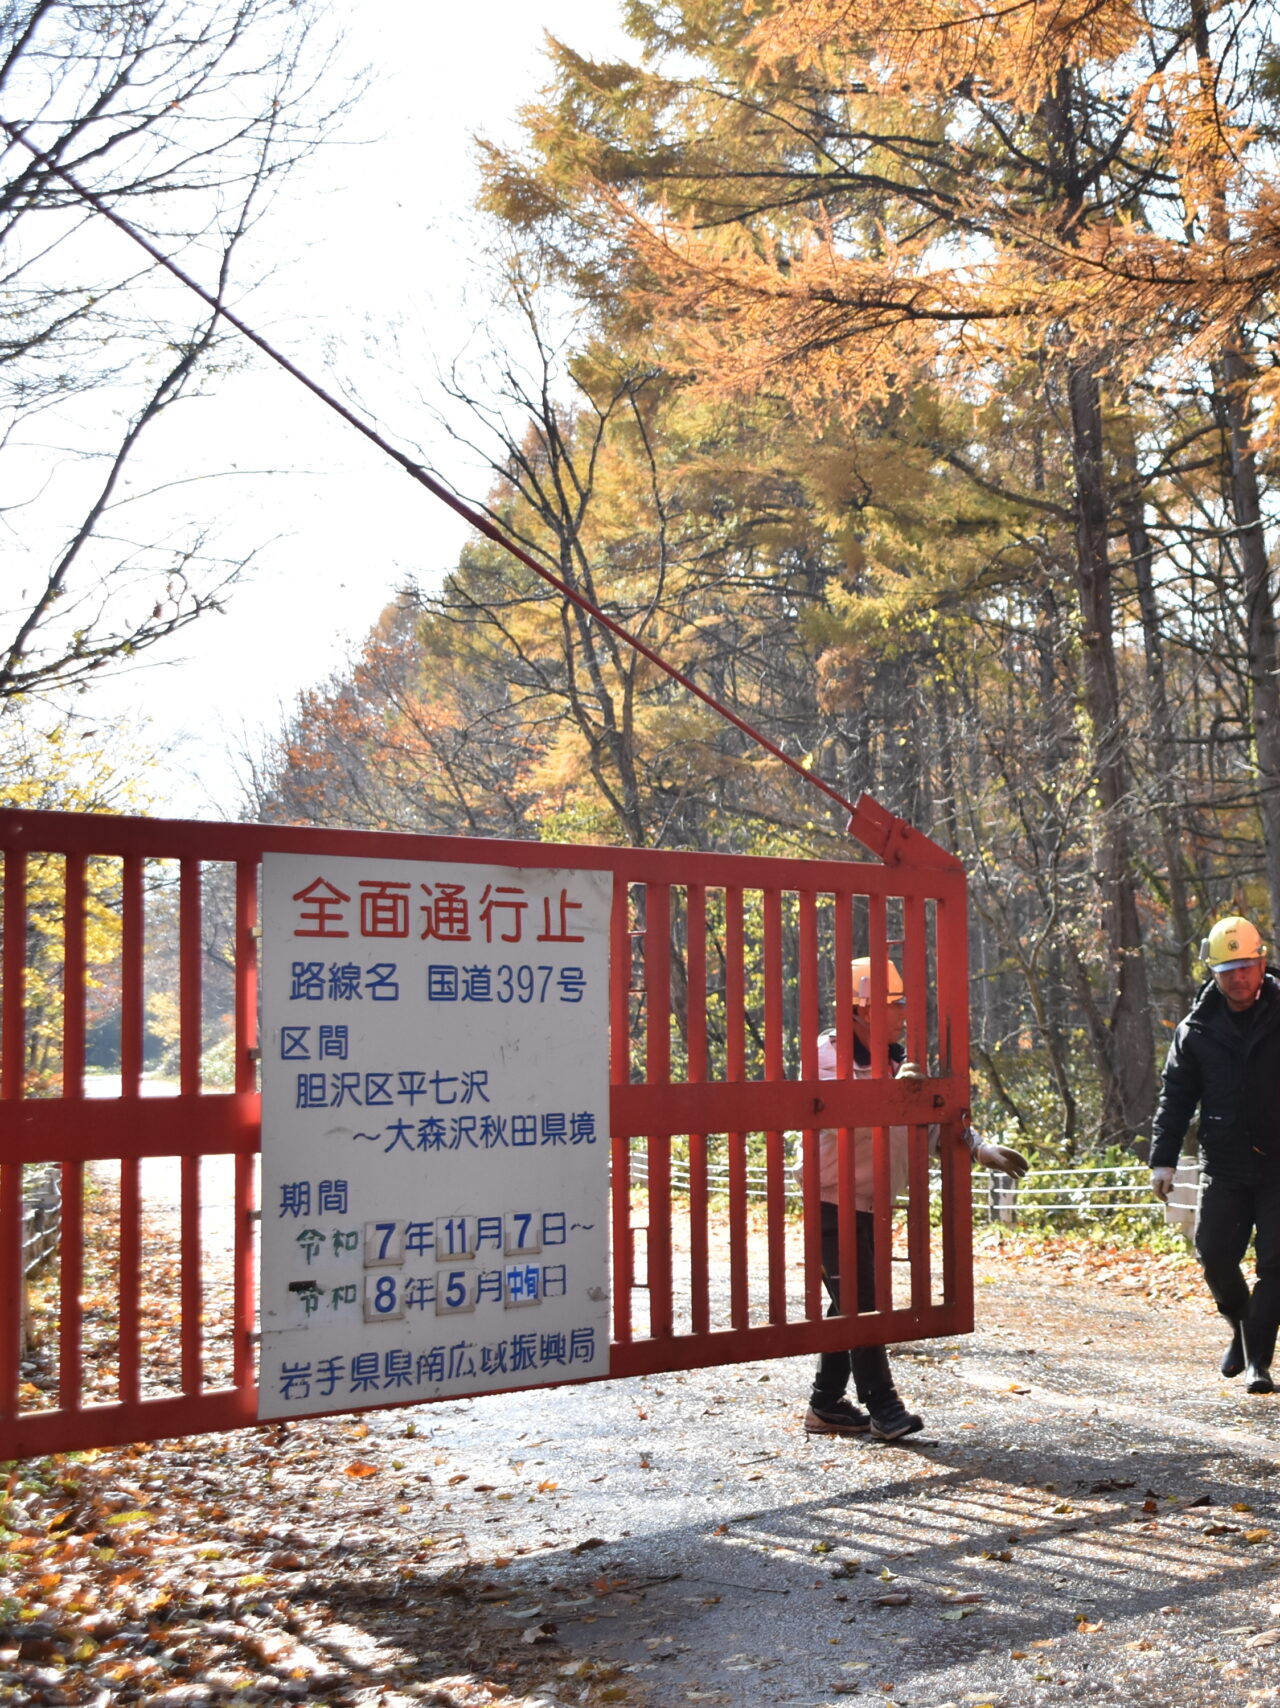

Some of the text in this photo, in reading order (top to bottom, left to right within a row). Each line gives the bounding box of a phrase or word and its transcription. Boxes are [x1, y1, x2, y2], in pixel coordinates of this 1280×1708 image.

[292, 876, 586, 943] 全面通行止
[289, 961, 588, 1004] 路線名 国道397号
[280, 1024, 349, 1061] 区間
[295, 1069, 491, 1109] 胆沢区平七沢
[279, 1179, 349, 1218] 期間
[279, 1326, 597, 1401] 岩手県県南広域振興局
